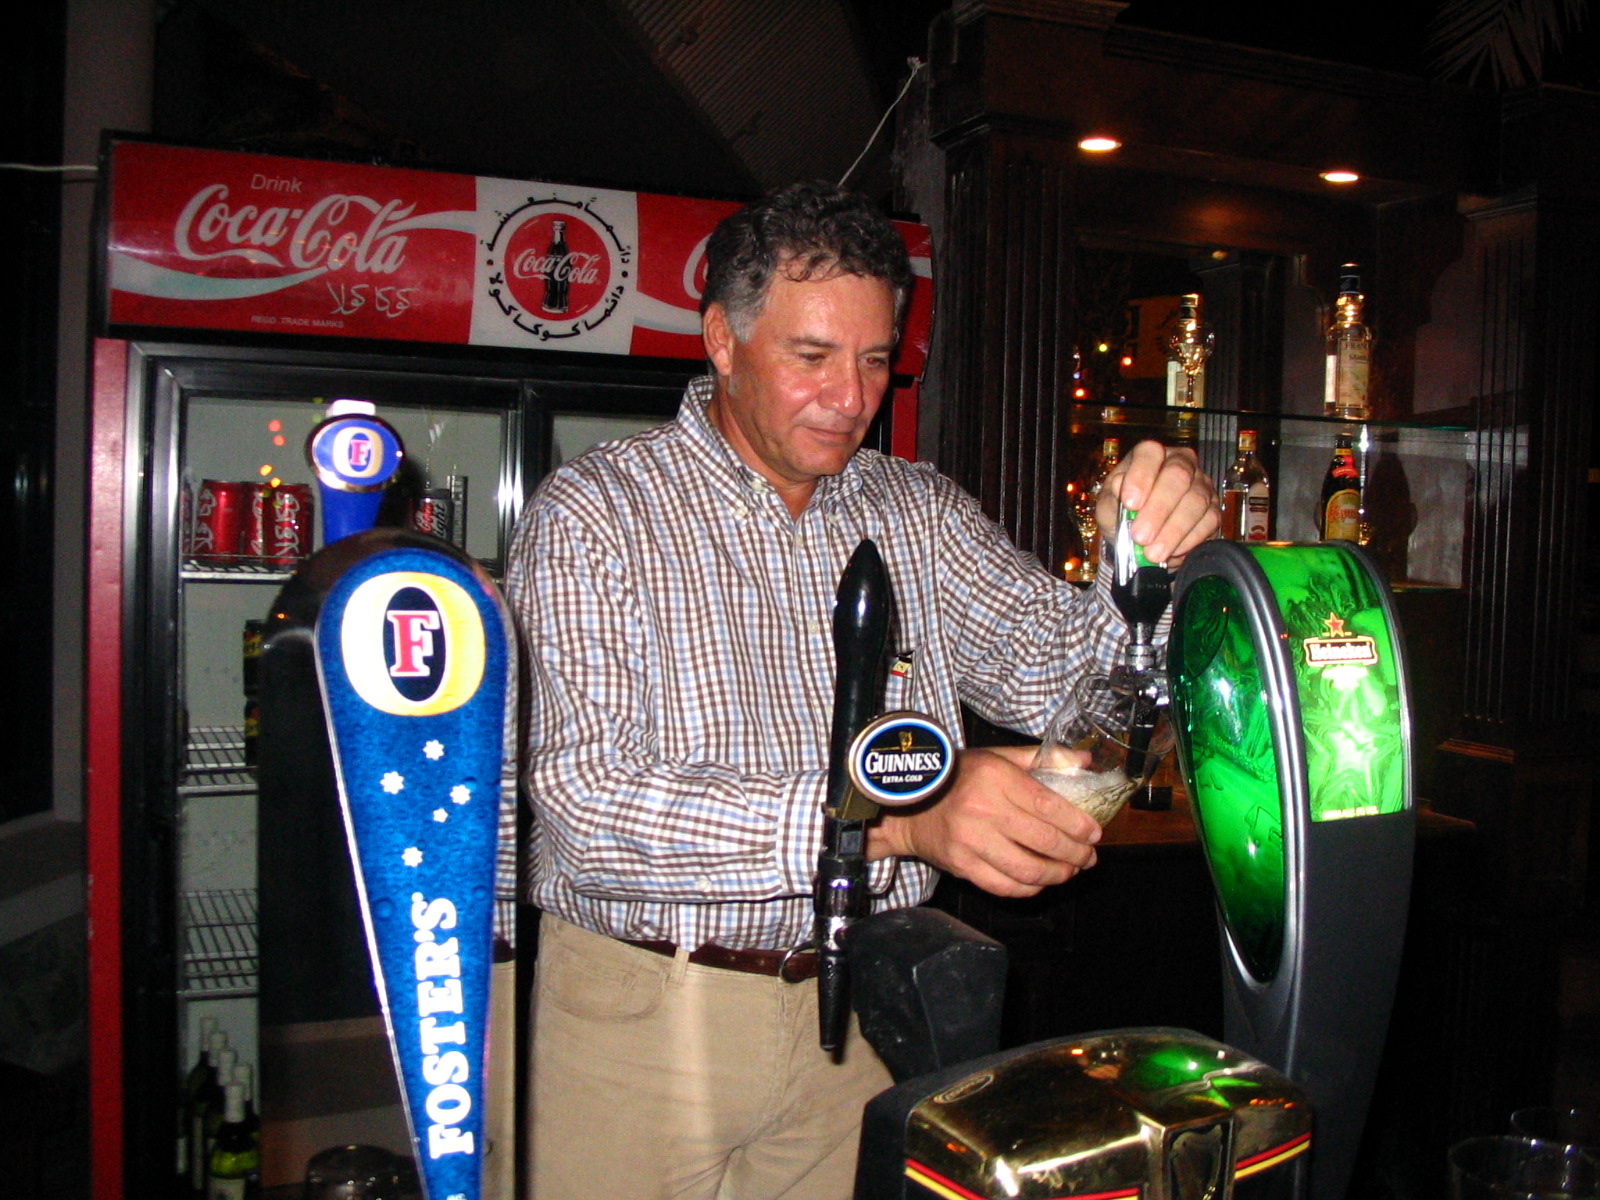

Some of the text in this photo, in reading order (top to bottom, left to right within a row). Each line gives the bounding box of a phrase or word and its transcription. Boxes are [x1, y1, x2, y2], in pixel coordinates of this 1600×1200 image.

[251, 173, 302, 193] Drink
[174, 183, 417, 275] Coca-Cola
[512, 248, 600, 284] Coca-Cola
[280, 317, 310, 327] TRADE
[312, 319, 345, 329] MARKS
[351, 439, 369, 465] F
[386, 609, 440, 677] F
[865, 751, 941, 774] GUINNESS
[882, 774, 923, 784] EXTRA COLD
[411, 892, 475, 1159] FOSTER'S
